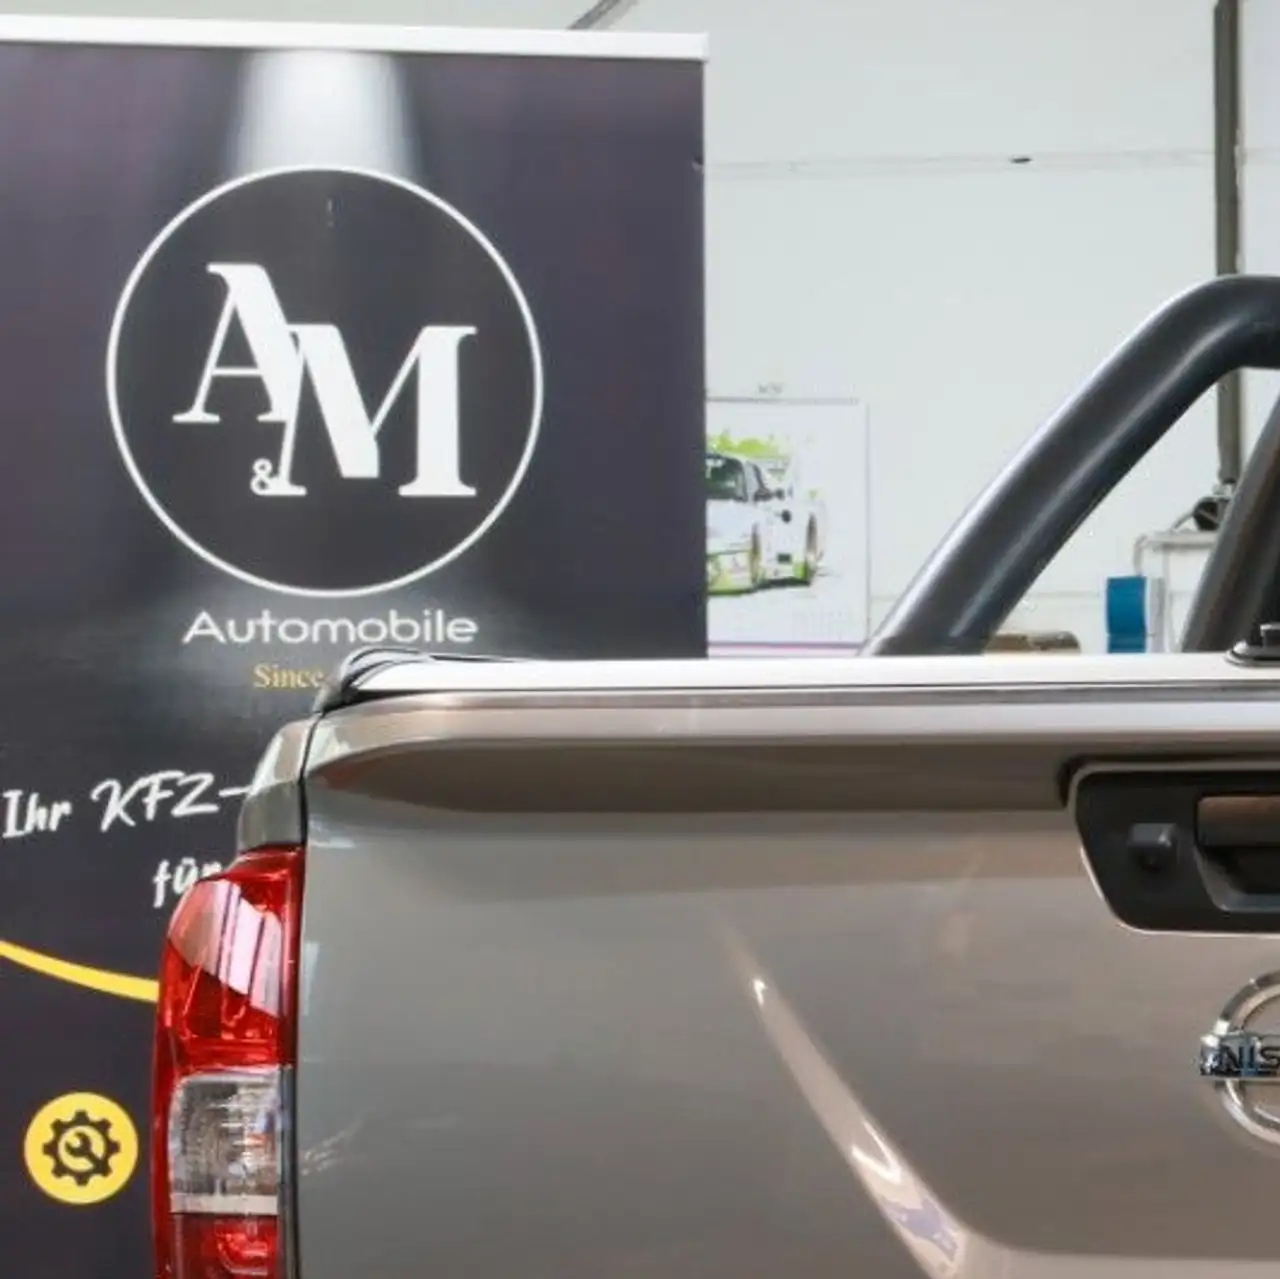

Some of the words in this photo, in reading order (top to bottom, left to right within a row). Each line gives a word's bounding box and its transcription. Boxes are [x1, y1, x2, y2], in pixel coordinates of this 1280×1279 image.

[182, 610, 478, 645] Automobile
[253, 662, 324, 689] Since
[2, 788, 73, 838] Ihr
